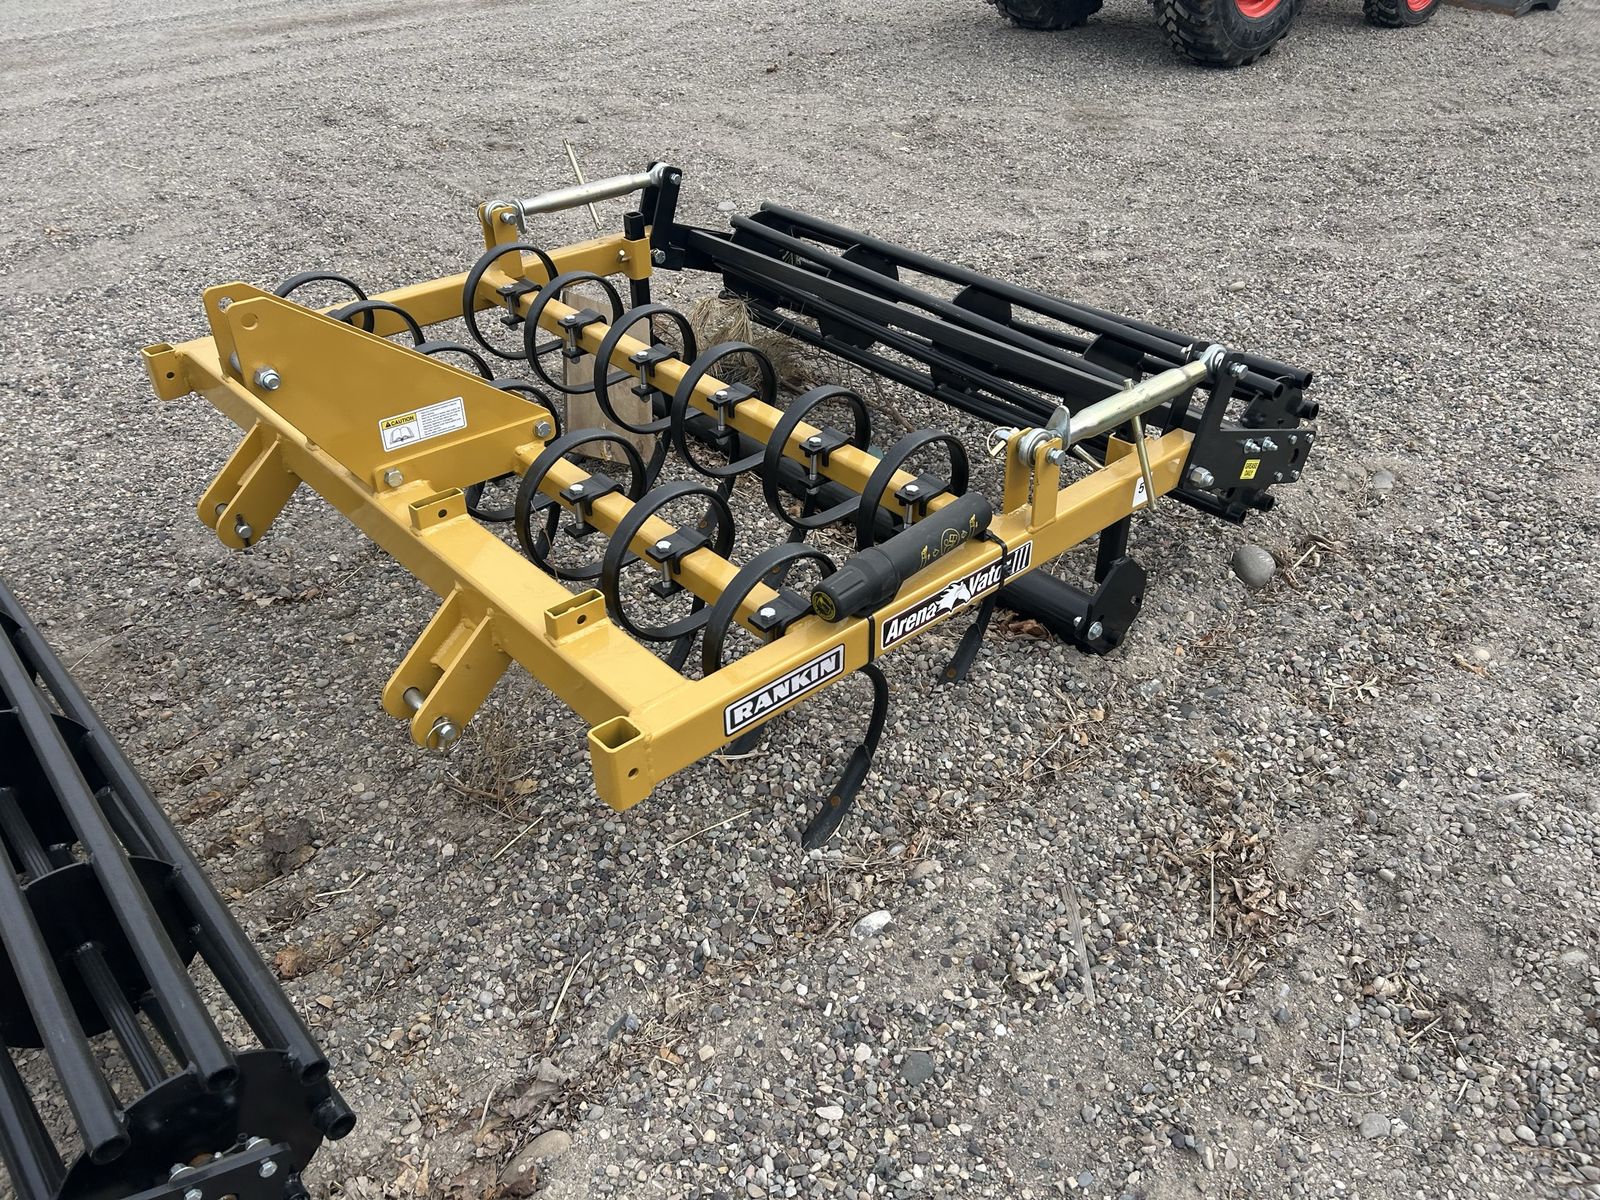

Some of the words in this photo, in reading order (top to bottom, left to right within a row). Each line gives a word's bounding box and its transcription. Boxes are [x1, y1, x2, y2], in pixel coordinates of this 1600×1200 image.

[391, 415, 414, 426] CAUTION
[885, 601, 938, 644] Arena
[733, 654, 837, 725] RANKIN
